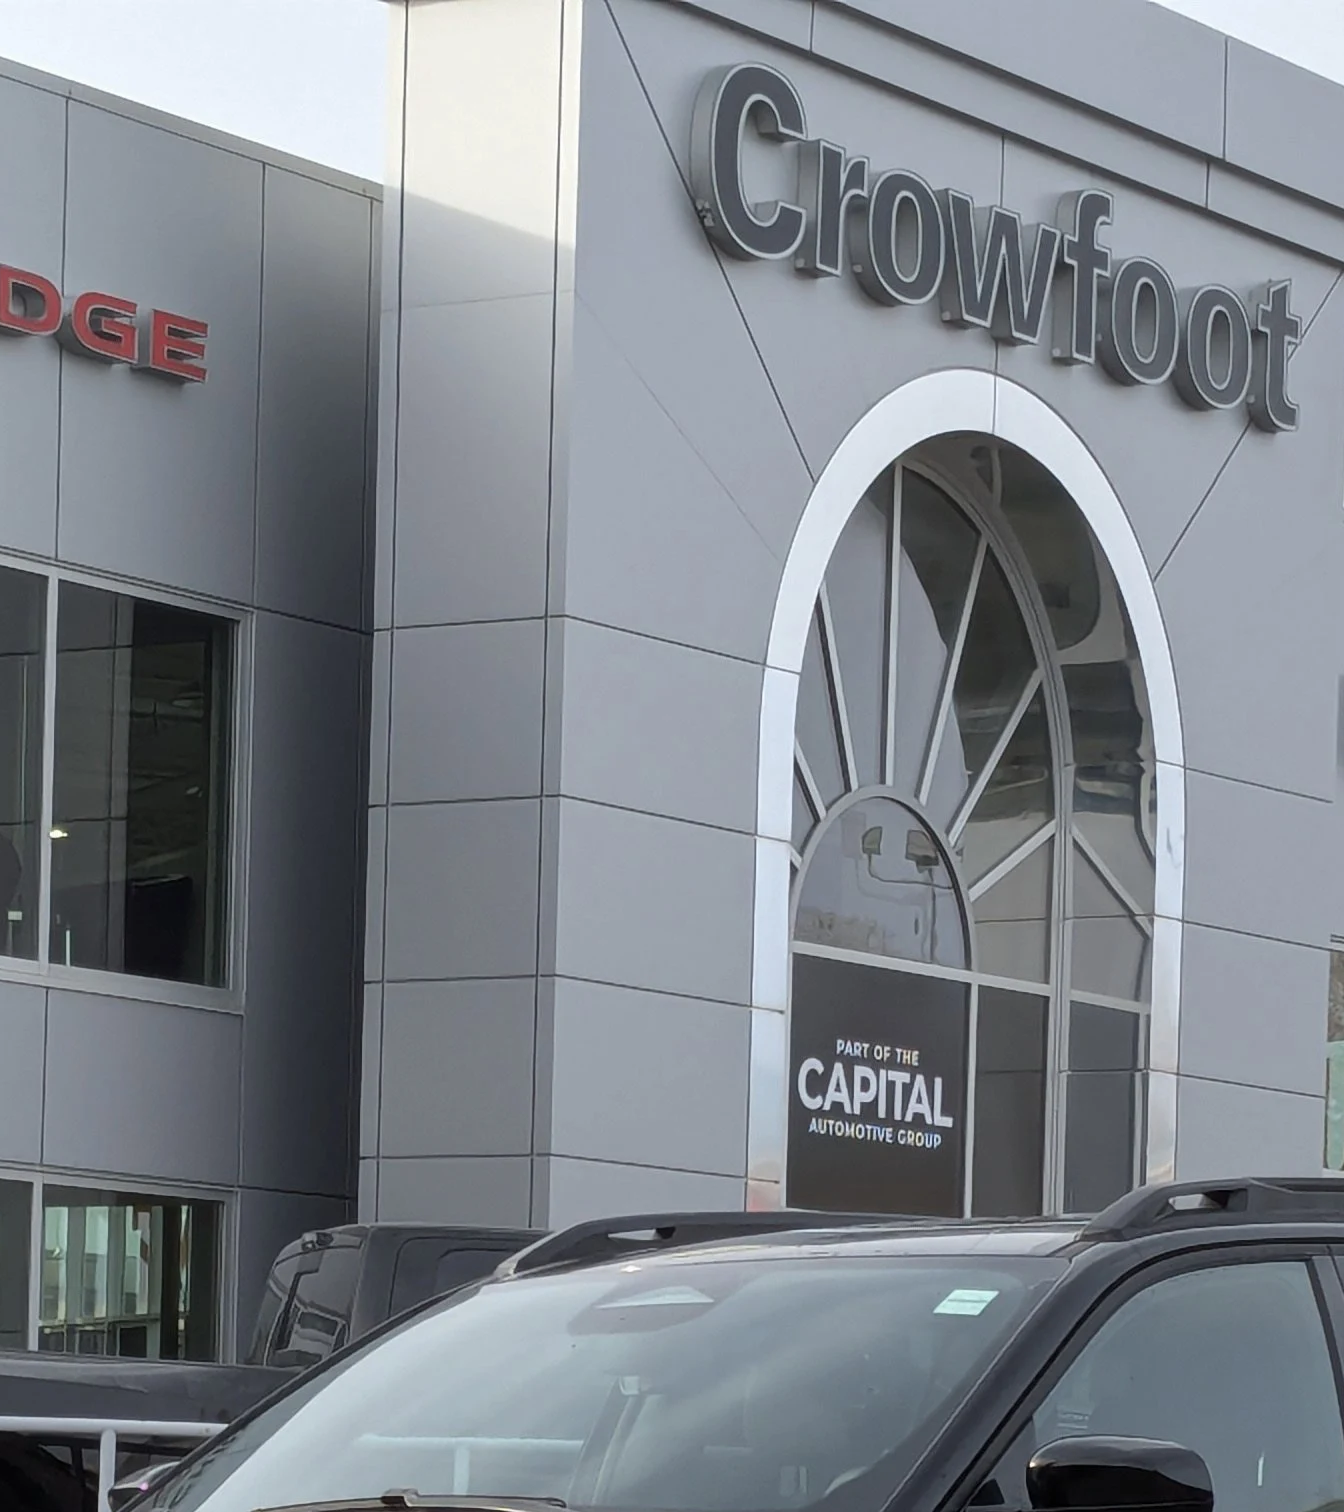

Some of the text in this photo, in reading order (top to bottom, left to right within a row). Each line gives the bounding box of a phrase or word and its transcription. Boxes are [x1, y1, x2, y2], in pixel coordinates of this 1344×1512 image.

[704, 61, 1302, 432] Crowfoot
[836, 1039, 920, 1067] PART OF THE
[797, 1057, 954, 1128] CAPITAL
[808, 1117, 943, 1149] AUTOMOTIVE GROUP
